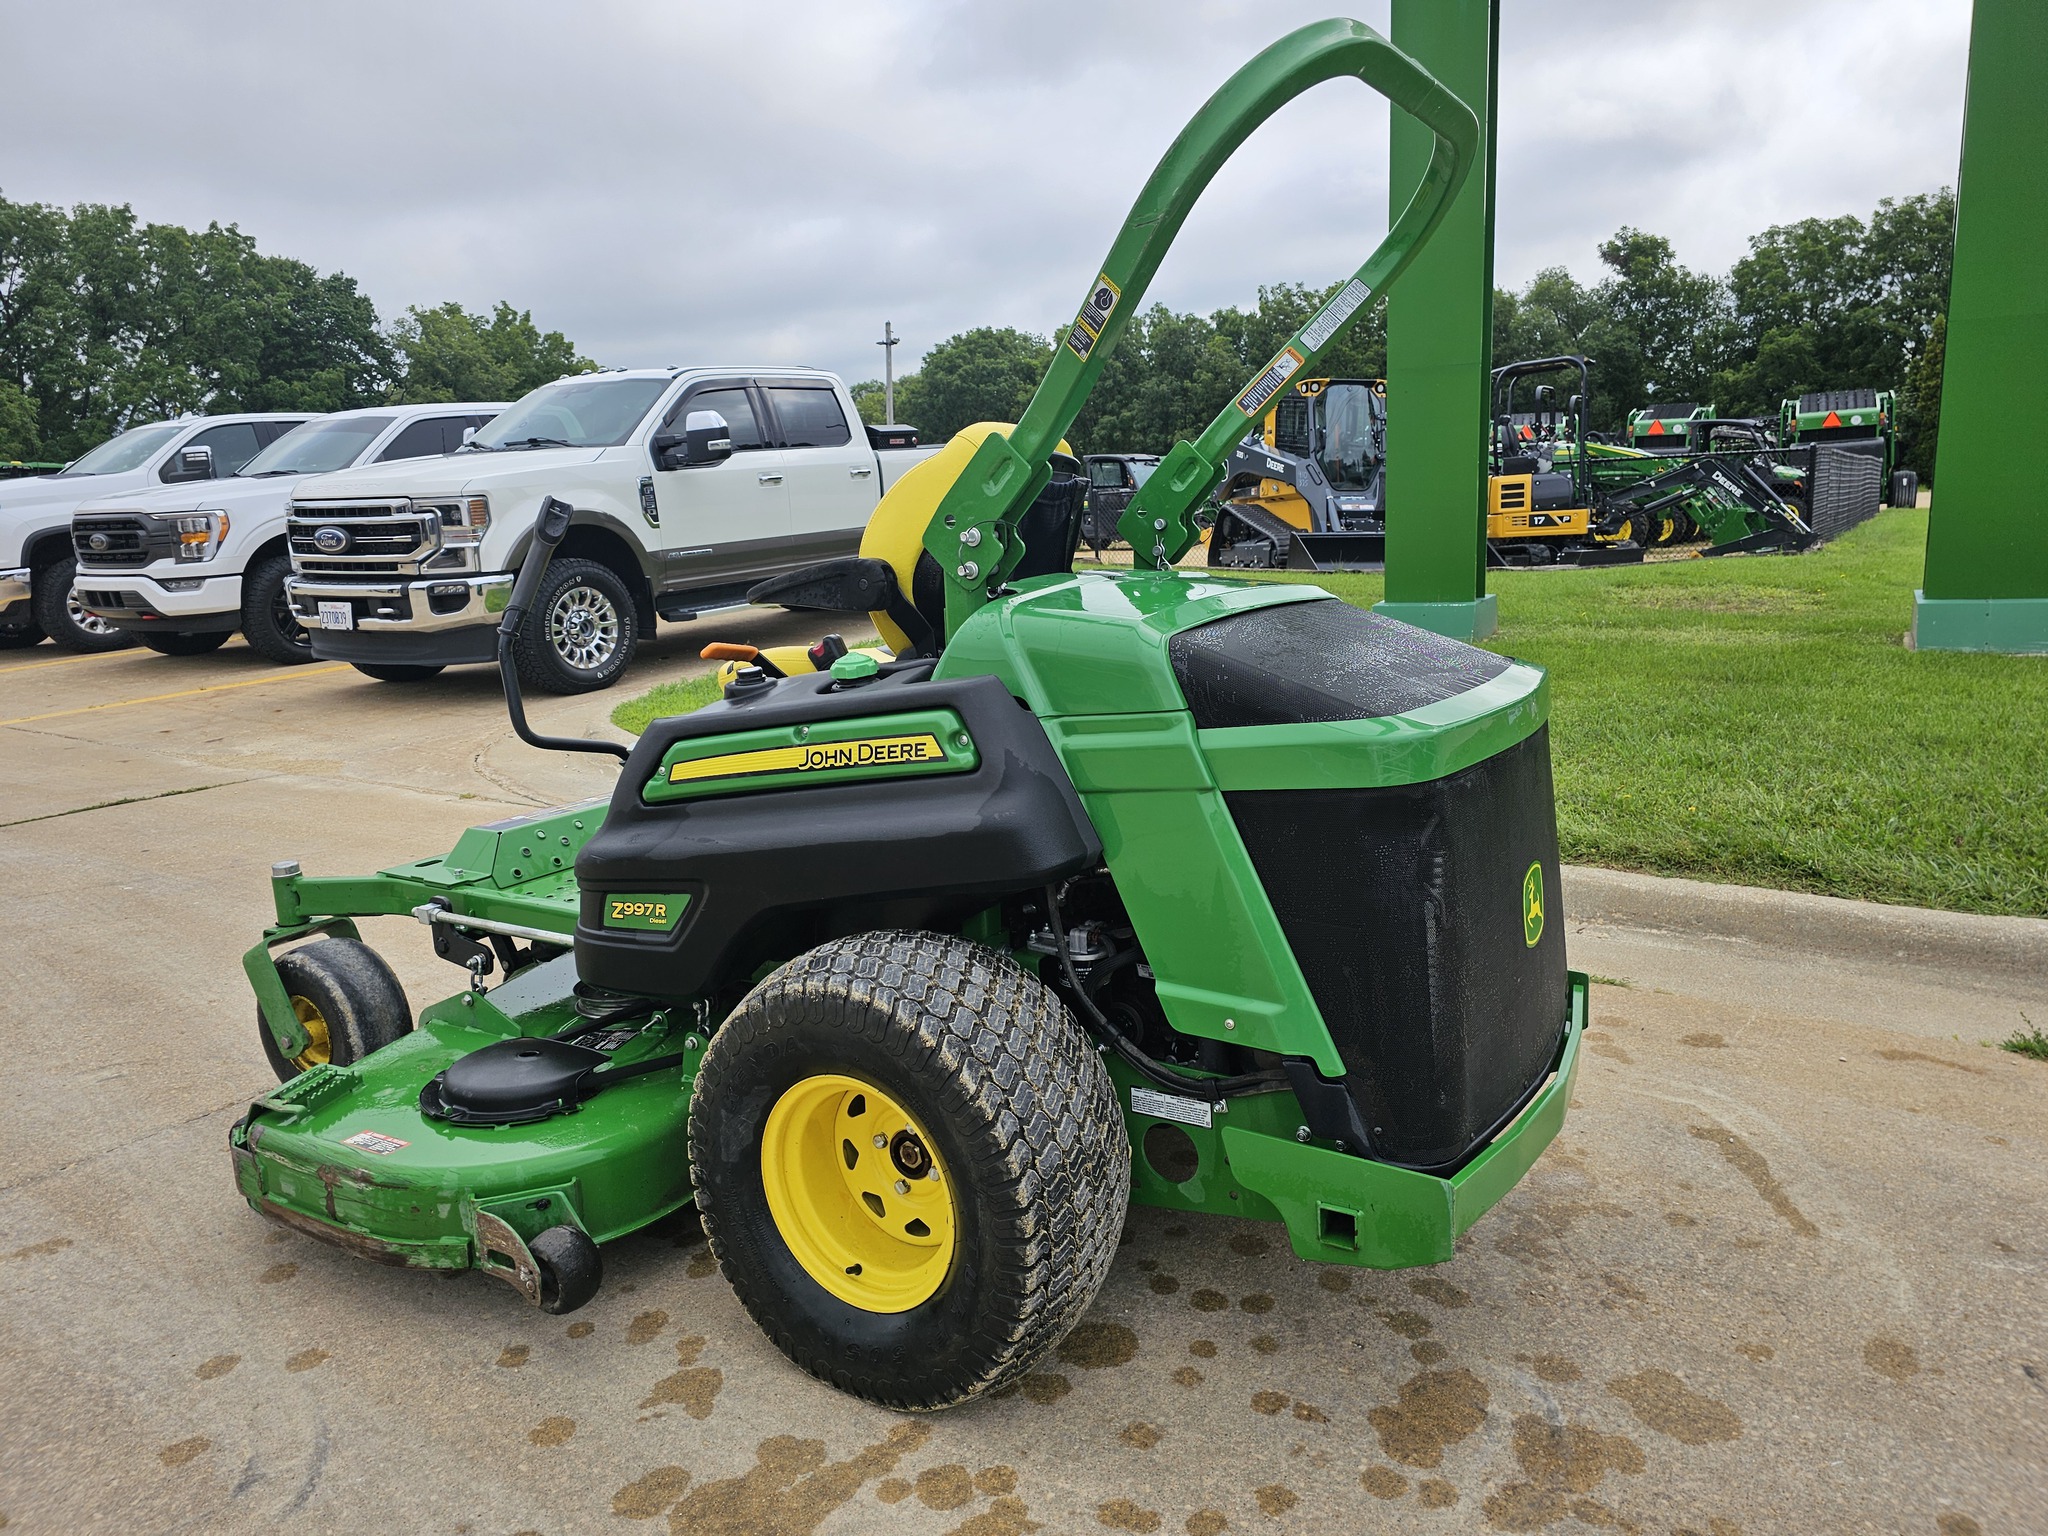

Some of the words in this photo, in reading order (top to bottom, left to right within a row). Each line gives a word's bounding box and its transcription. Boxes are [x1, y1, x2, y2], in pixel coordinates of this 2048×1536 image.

[1266, 457, 1285, 474] DEERE
[1711, 470, 1744, 498] DEERE
[1533, 516, 1546, 525] 17
[319, 533, 337, 546] Ford
[798, 748, 852, 768] JOHN
[858, 742, 927, 763] DEERE
[649, 917, 667, 925] Diesel
